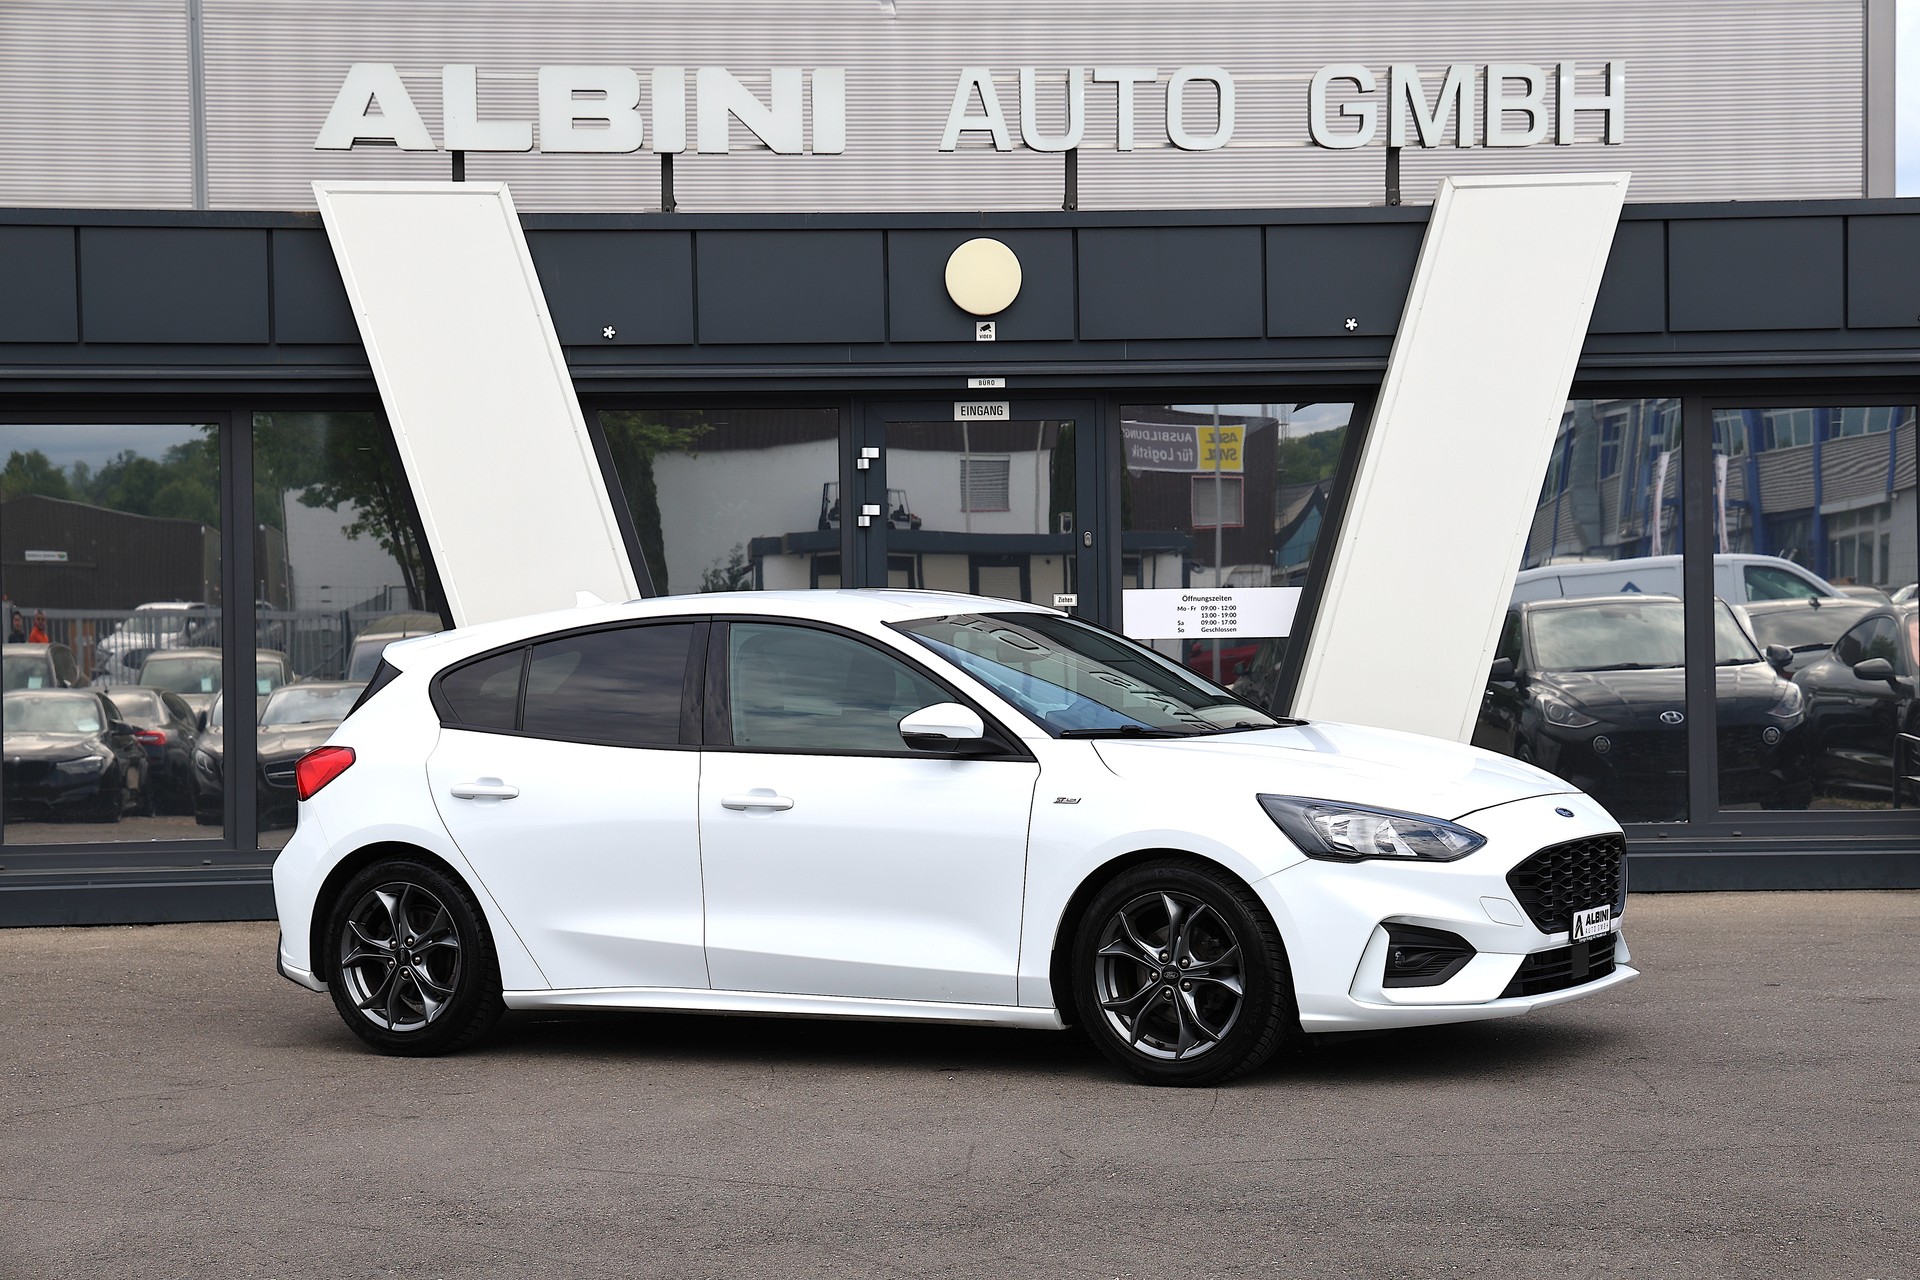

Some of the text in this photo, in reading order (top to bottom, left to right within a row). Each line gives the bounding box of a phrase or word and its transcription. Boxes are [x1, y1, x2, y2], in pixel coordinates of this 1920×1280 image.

[313, 60, 1626, 155] ALBINI AUTO GMBH
[960, 405, 1003, 416] EINGANG
[1181, 594, 1232, 603] Öffnungszeiten
[1585, 909, 1609, 926] ALBINI
